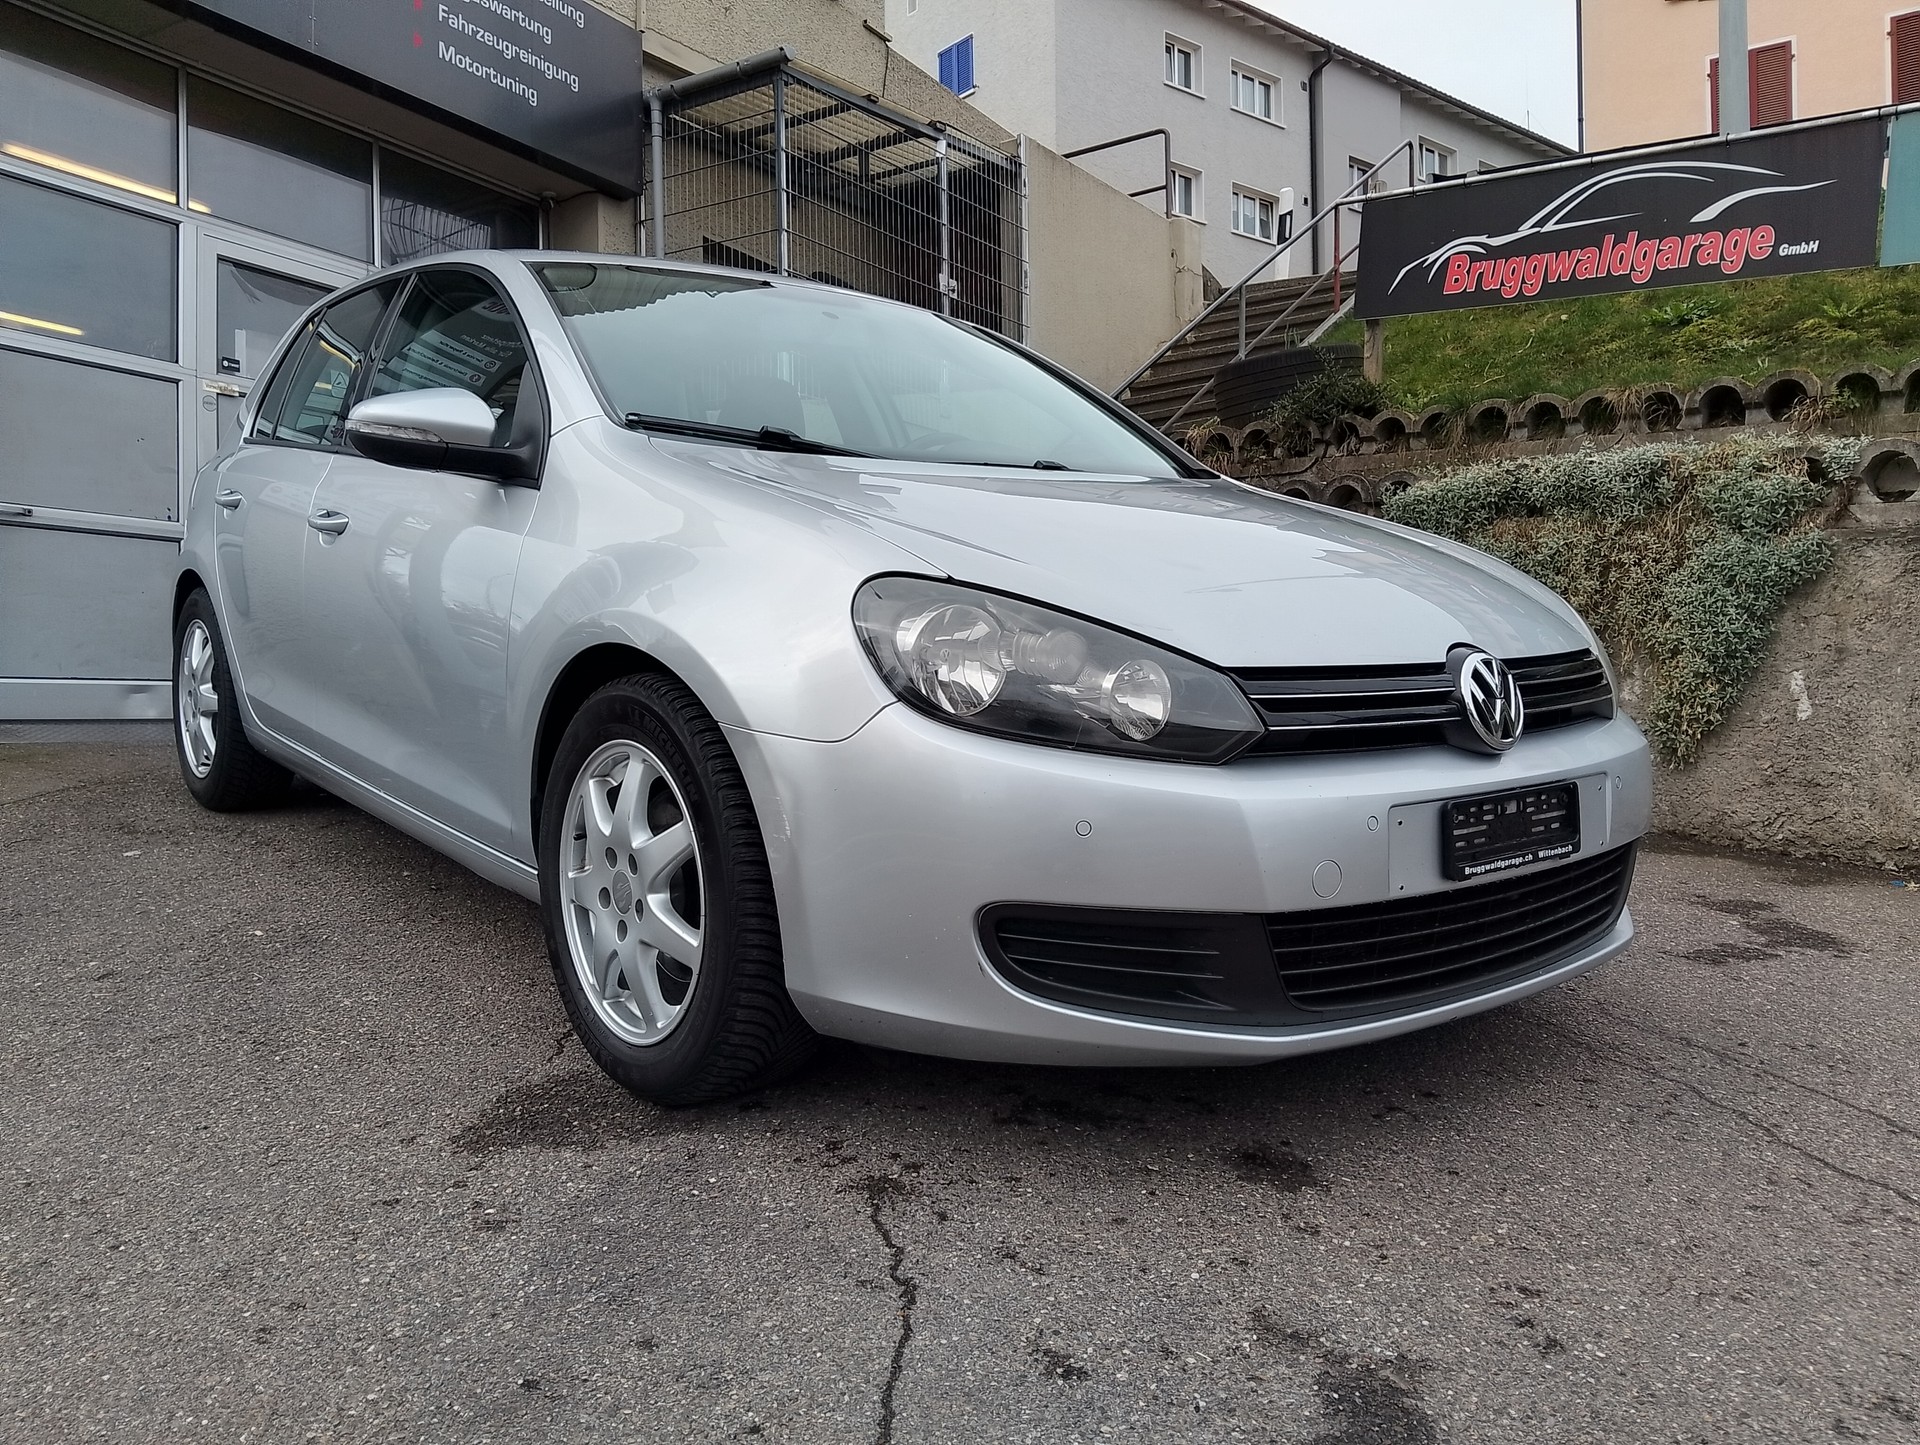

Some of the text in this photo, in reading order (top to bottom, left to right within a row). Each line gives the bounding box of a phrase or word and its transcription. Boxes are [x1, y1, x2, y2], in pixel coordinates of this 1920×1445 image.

[438, 3, 579, 92] Fahrzeugreinigung
[463, 0, 552, 45] swartung
[438, 40, 538, 106] Motortuning
[1443, 224, 1820, 299] Bruggwaldgarage GmbH
[1464, 844, 1573, 875] Bruggwaldgarage.ch Wittenbach
